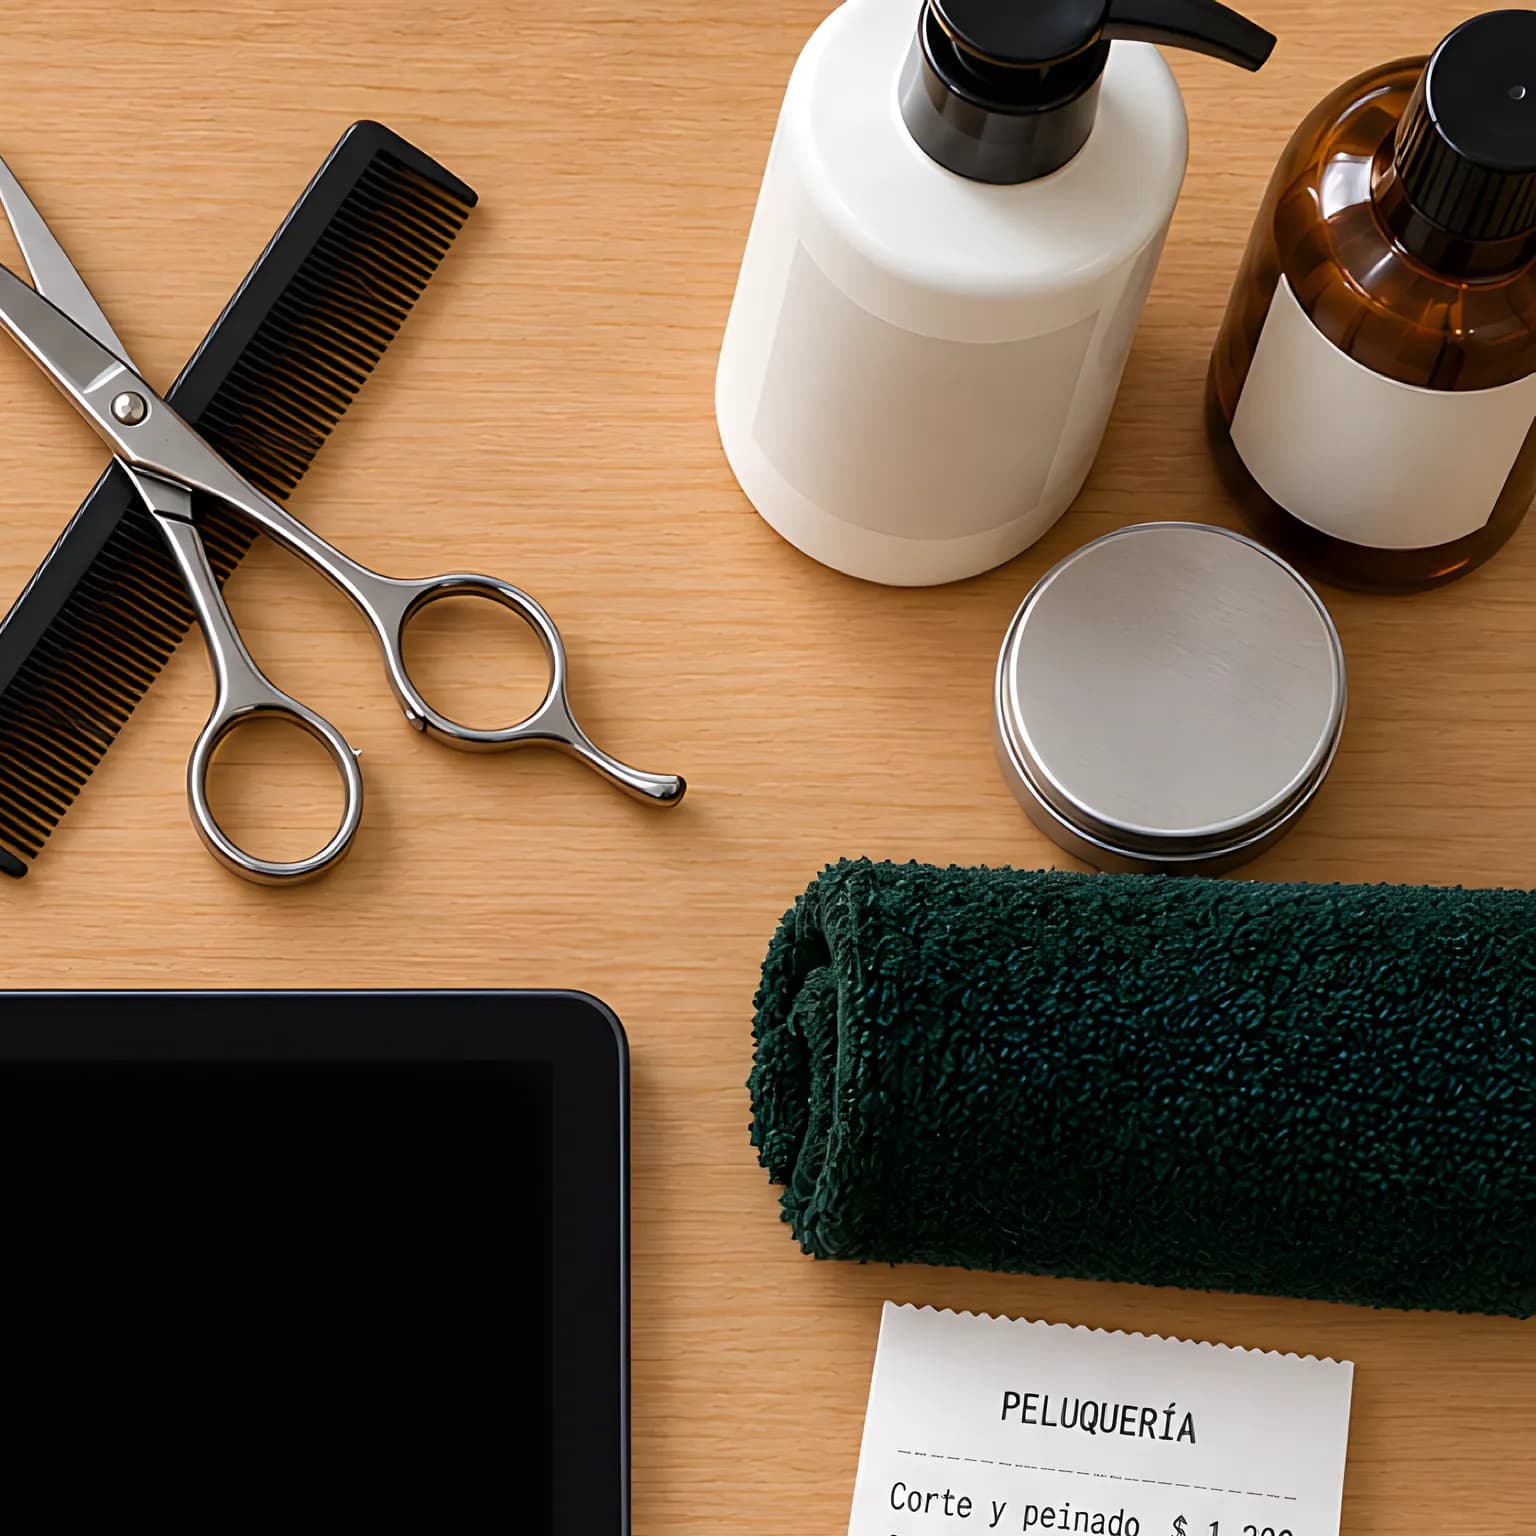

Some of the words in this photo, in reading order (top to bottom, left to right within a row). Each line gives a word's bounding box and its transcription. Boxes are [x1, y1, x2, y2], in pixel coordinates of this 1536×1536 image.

[1001, 1390, 1196, 1445] PELUQUERÍA
[890, 1481, 973, 1519] Corte
[988, 1500, 1008, 1528] y
